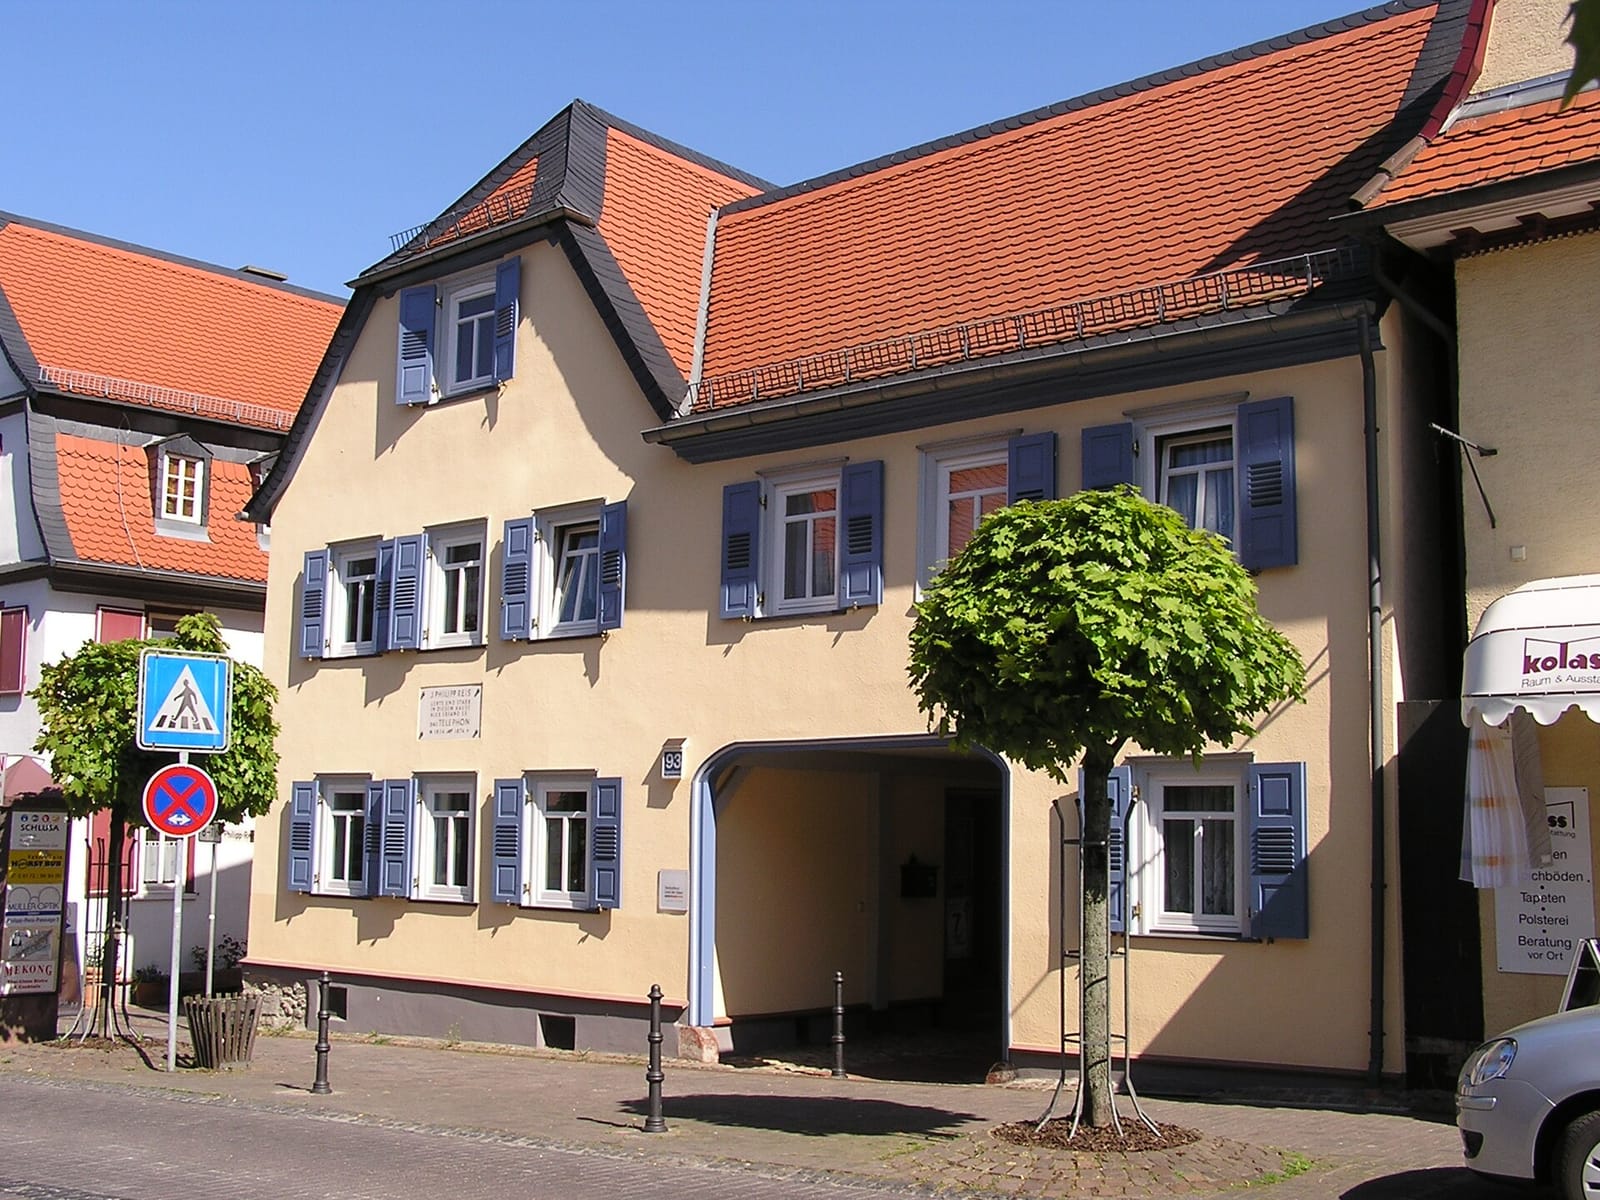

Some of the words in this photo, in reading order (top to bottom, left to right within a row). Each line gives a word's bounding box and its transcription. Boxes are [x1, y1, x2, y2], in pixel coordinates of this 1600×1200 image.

[1523, 643, 1600, 674] kolas
[1521, 677, 1551, 688] Raum
[1554, 675, 1562, 683] &
[666, 753, 681, 769] 93
[1550, 830, 1576, 839] tattung
[1531, 871, 1584, 882] chböden
[1520, 892, 1566, 905] Tapeten
[1518, 913, 1569, 926] Polsterei
[1518, 935, 1572, 951] Beratung
[1527, 952, 1543, 960] vor
[1546, 951, 1564, 961] Ort
[5, 965, 53, 977] MEKONG
